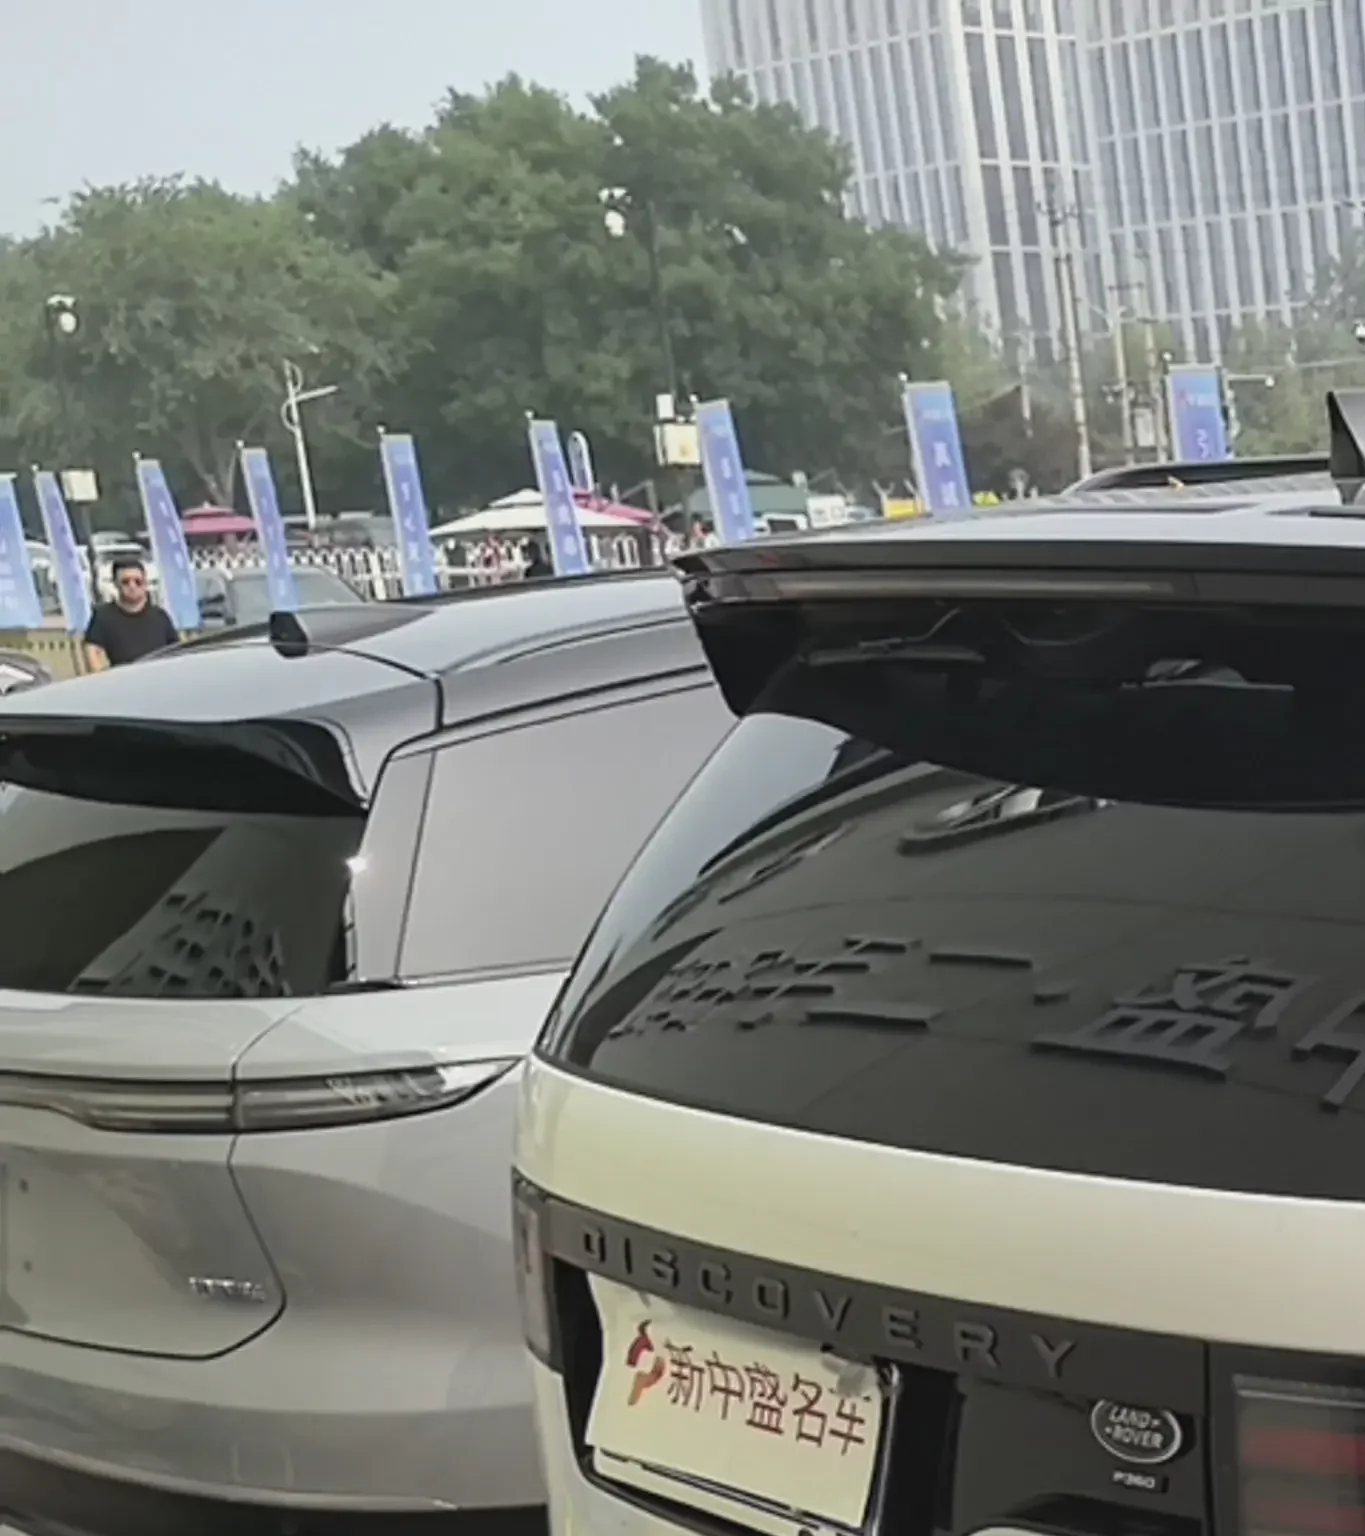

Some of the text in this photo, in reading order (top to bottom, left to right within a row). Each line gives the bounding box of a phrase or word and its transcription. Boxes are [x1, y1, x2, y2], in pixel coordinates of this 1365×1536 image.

[581, 1225, 1078, 1380] DISCOVERY
[663, 1338, 873, 1457] 新中盛名车
[1109, 1407, 1151, 1428] LAND
[1112, 1425, 1163, 1448] ROVER
